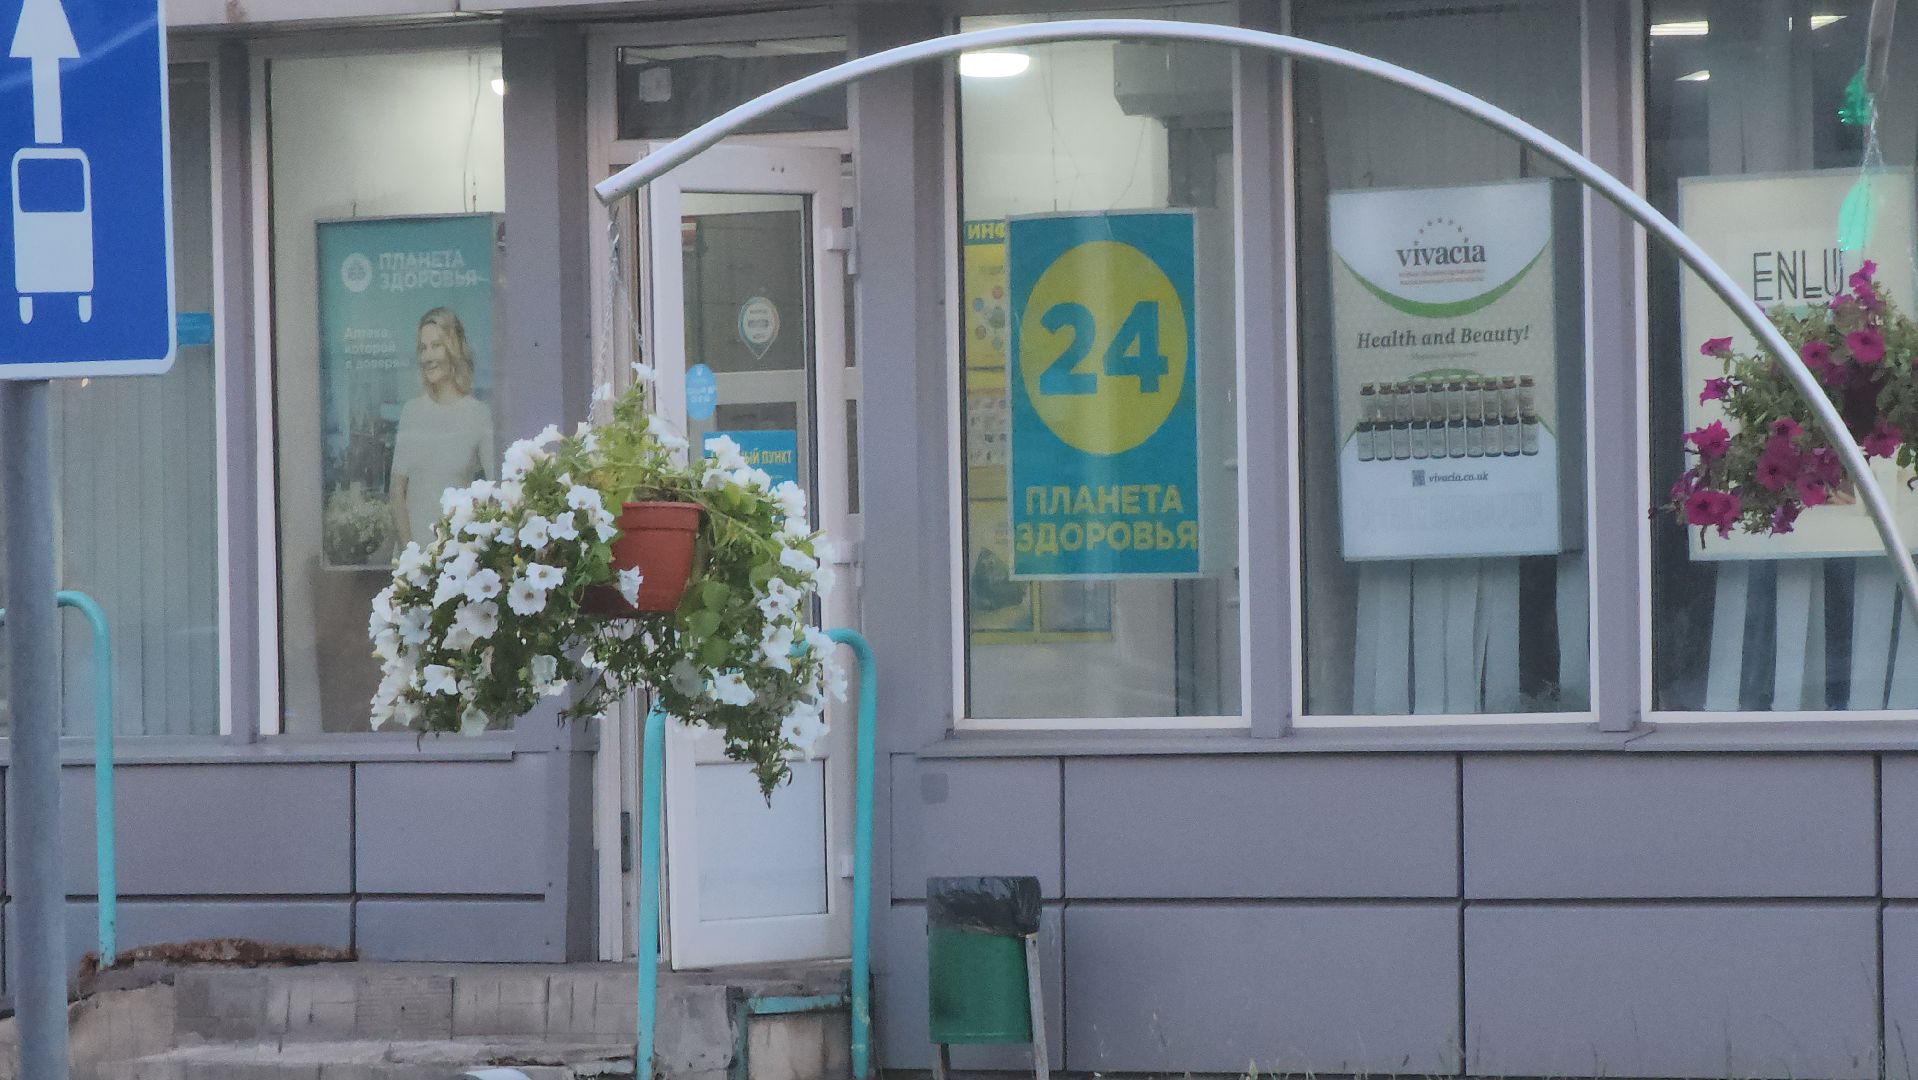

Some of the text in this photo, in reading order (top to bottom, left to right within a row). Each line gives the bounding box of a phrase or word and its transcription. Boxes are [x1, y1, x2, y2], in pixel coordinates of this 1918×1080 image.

[379, 250, 465, 270] ПЛАНЕТА
[1396, 241, 1486, 267] vivacia
[381, 270, 477, 292] ЗДОРОВЬЯ
[1753, 247, 1845, 302] ENLU
[1039, 300, 1170, 396] 24
[1357, 325, 1530, 351] Health and Beauty!
[762, 449, 792, 465] ПУНКТ
[1428, 470, 1489, 483] vivacia.co.uk
[1025, 484, 1183, 516] ПЛАНЕТА
[1016, 520, 1198, 557] ЗДОРОВЬЯ
